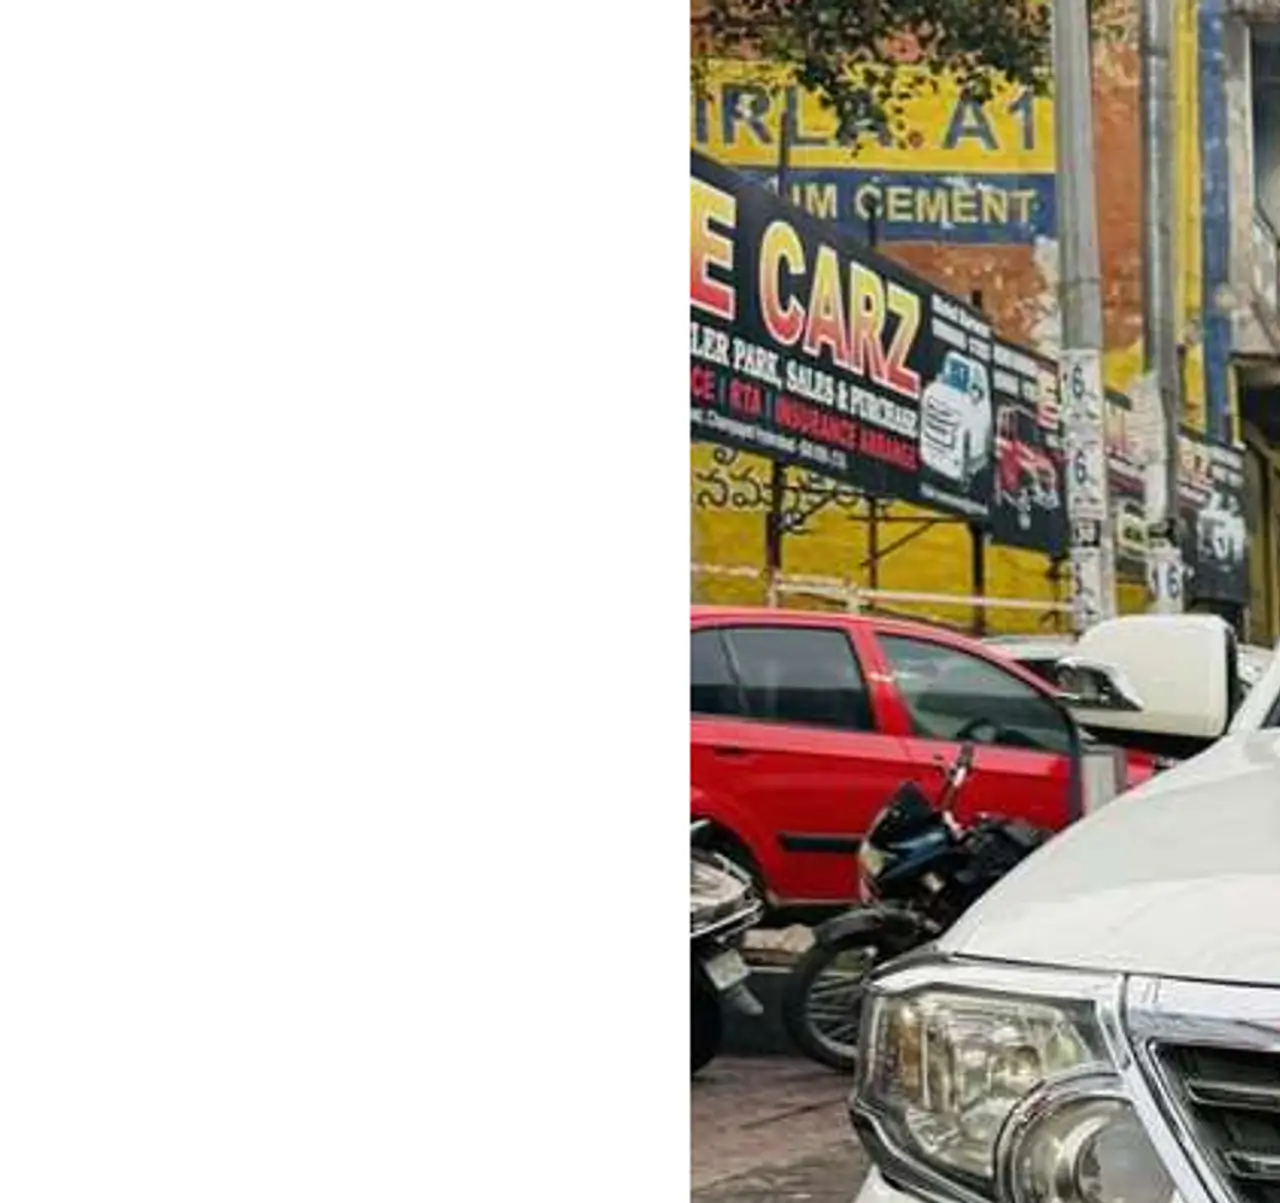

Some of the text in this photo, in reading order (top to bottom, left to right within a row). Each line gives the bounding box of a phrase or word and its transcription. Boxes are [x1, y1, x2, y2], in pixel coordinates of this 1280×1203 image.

[942, 86, 1035, 149] A1
[855, 184, 1036, 223] CEMENT
[760, 217, 922, 399] CARZ
